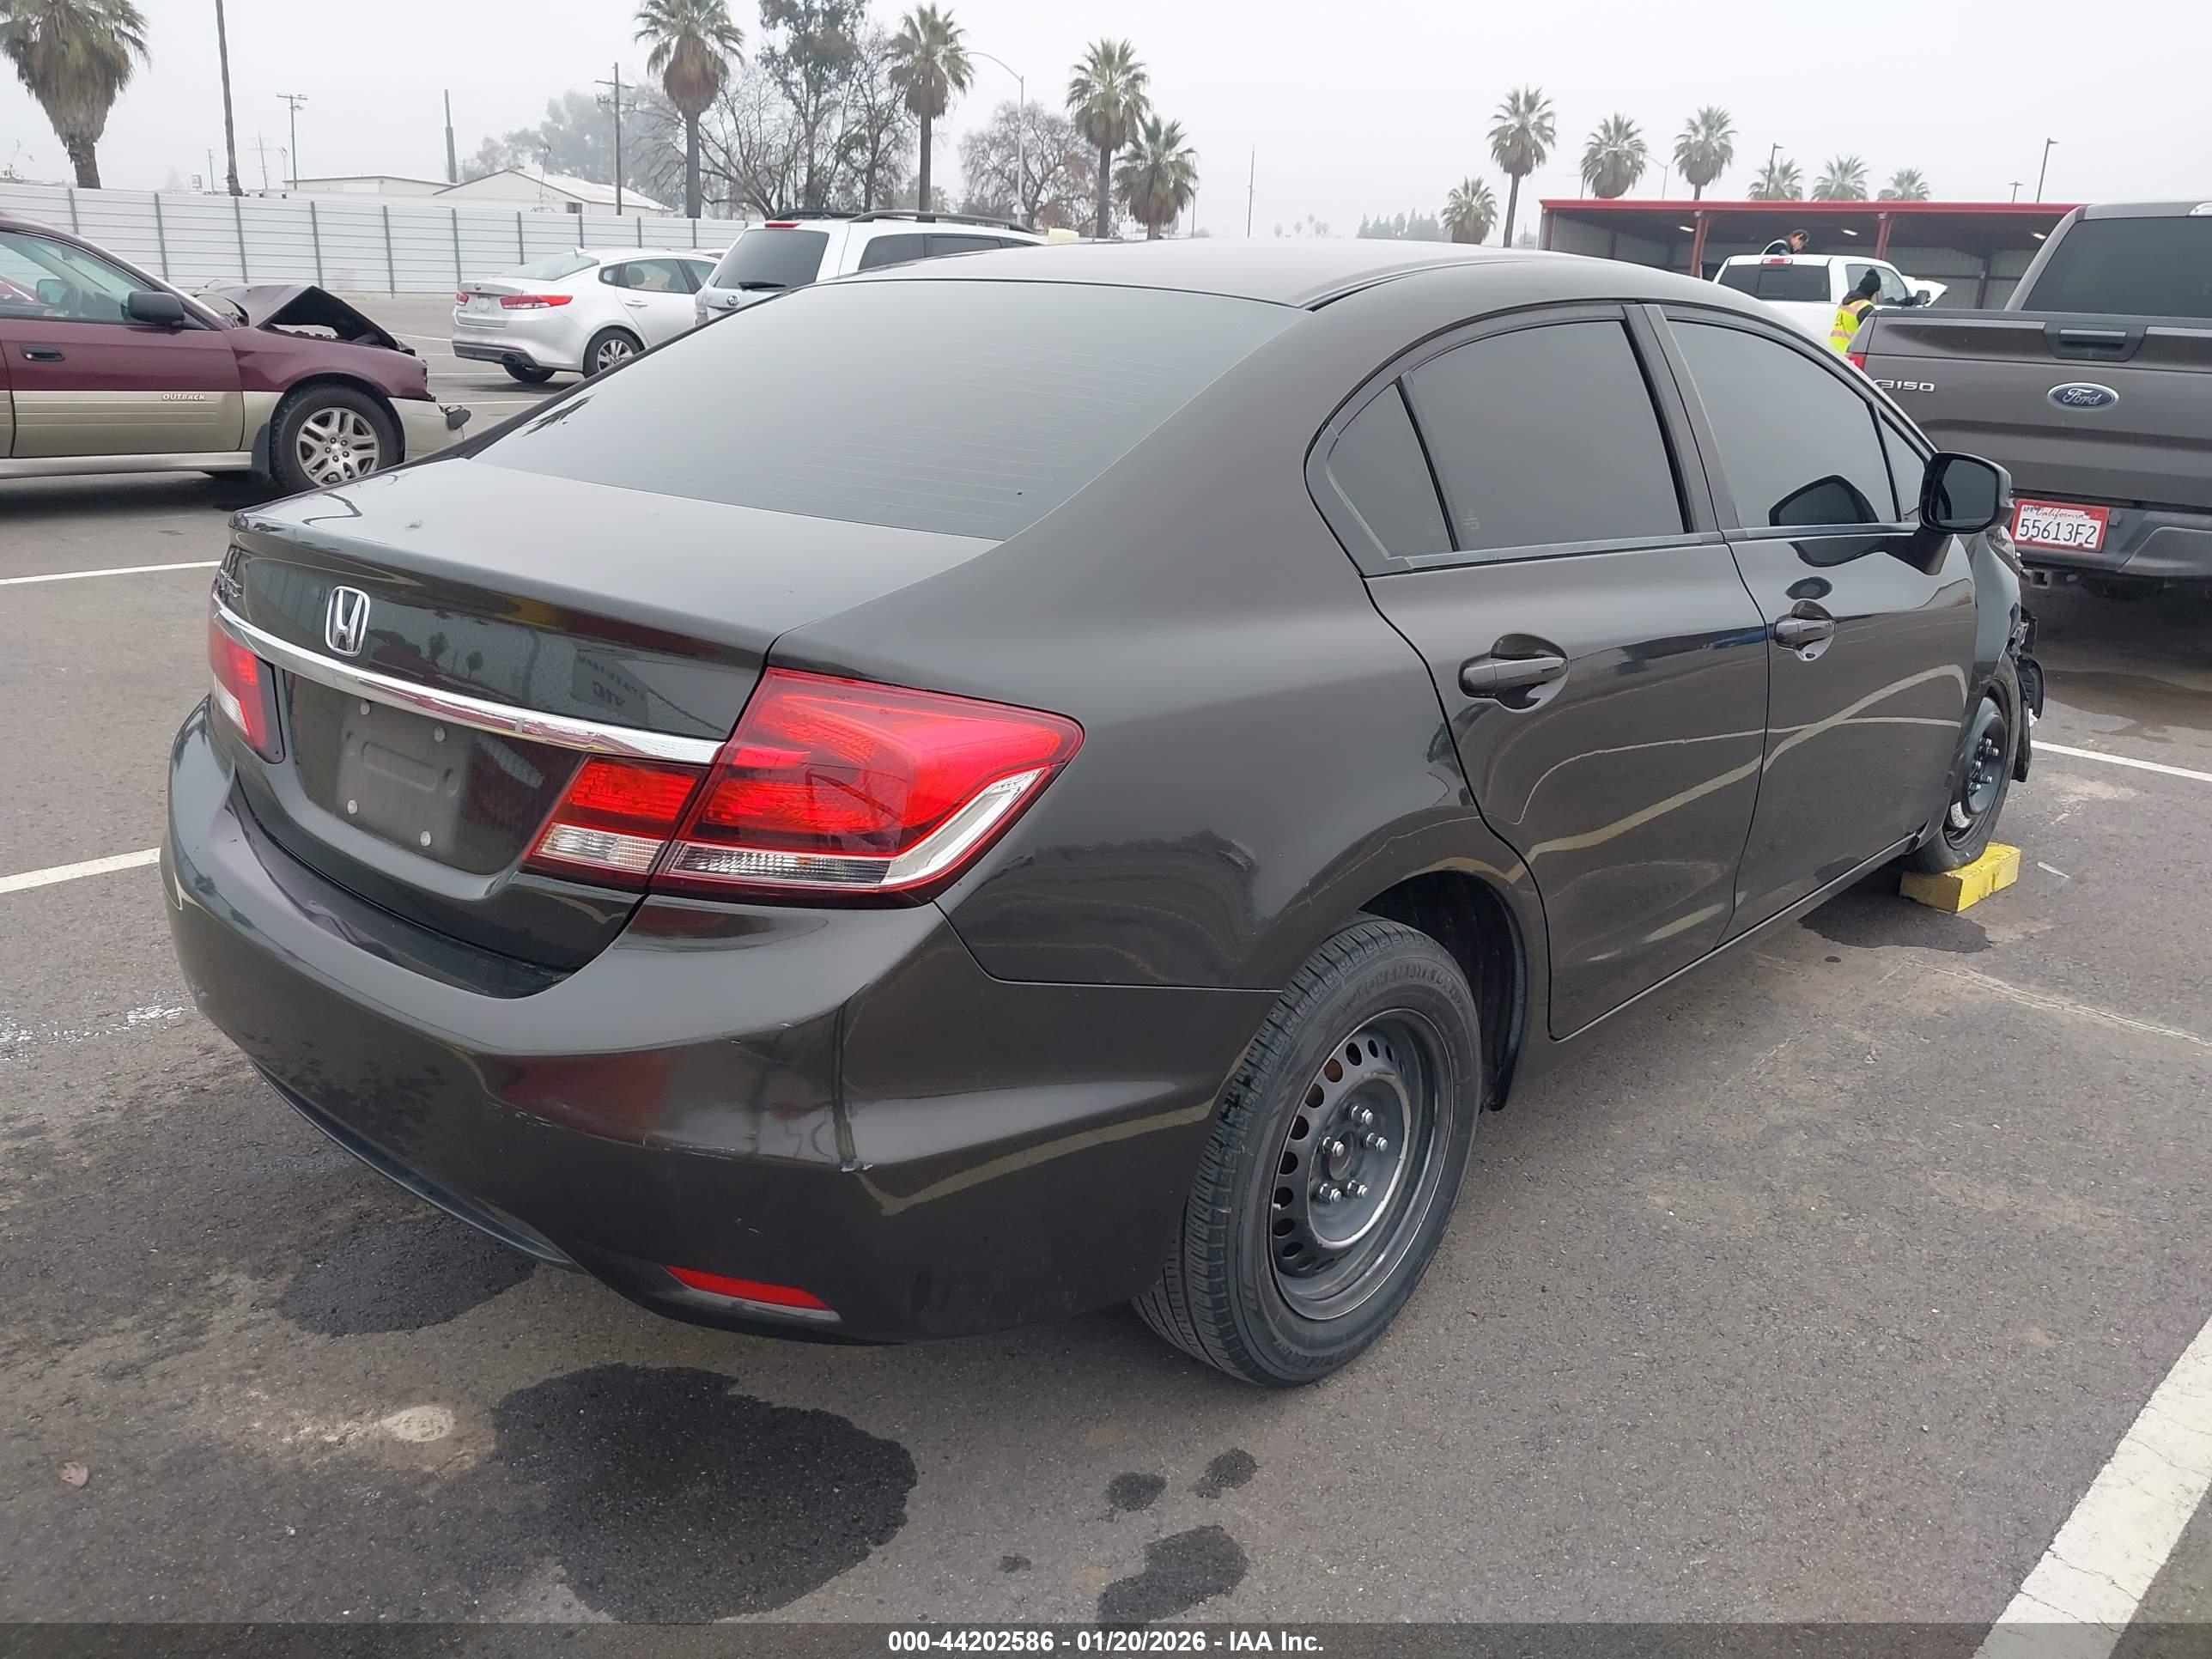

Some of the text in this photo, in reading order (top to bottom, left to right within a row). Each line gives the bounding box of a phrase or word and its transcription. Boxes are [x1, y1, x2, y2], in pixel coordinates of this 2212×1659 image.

[2062, 388, 2102, 404] Ford
[2036, 507, 2085, 520] California
[2020, 517, 2098, 544] 55613F2
